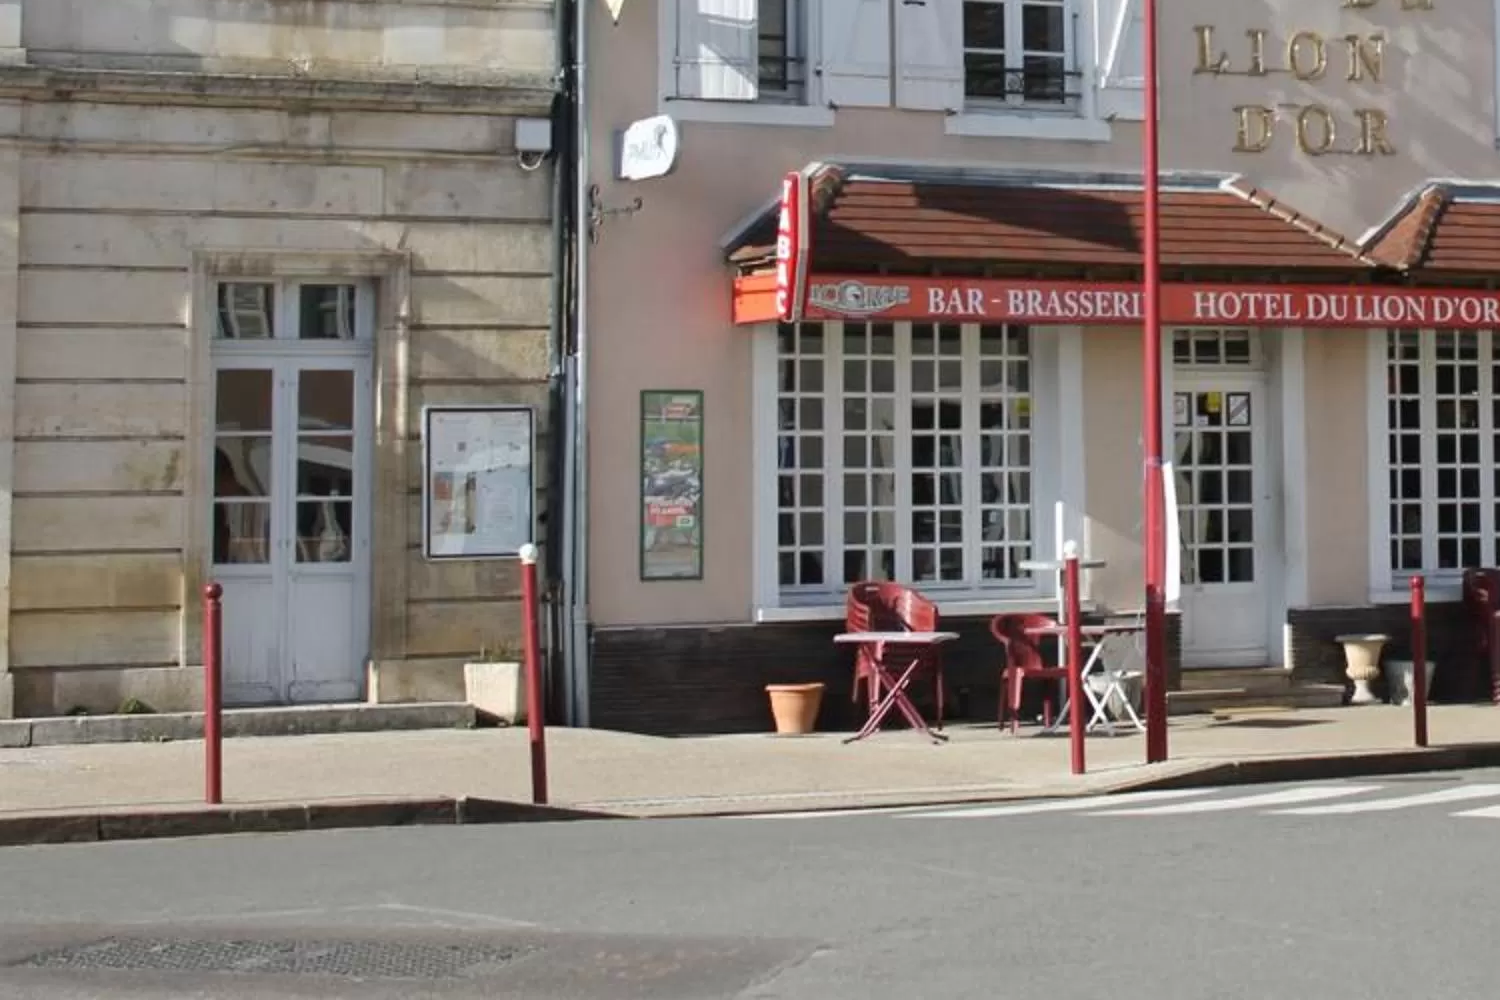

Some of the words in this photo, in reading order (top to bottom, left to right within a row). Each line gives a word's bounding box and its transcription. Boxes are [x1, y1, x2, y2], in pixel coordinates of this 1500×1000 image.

[1193, 24, 1386, 81] LION
[775, 179, 792, 315] TABAC
[928, 287, 985, 315] BAR
[1193, 291, 1299, 321] HOTEL
[1306, 293, 1348, 321] DU
[1356, 294, 1426, 322] LION
